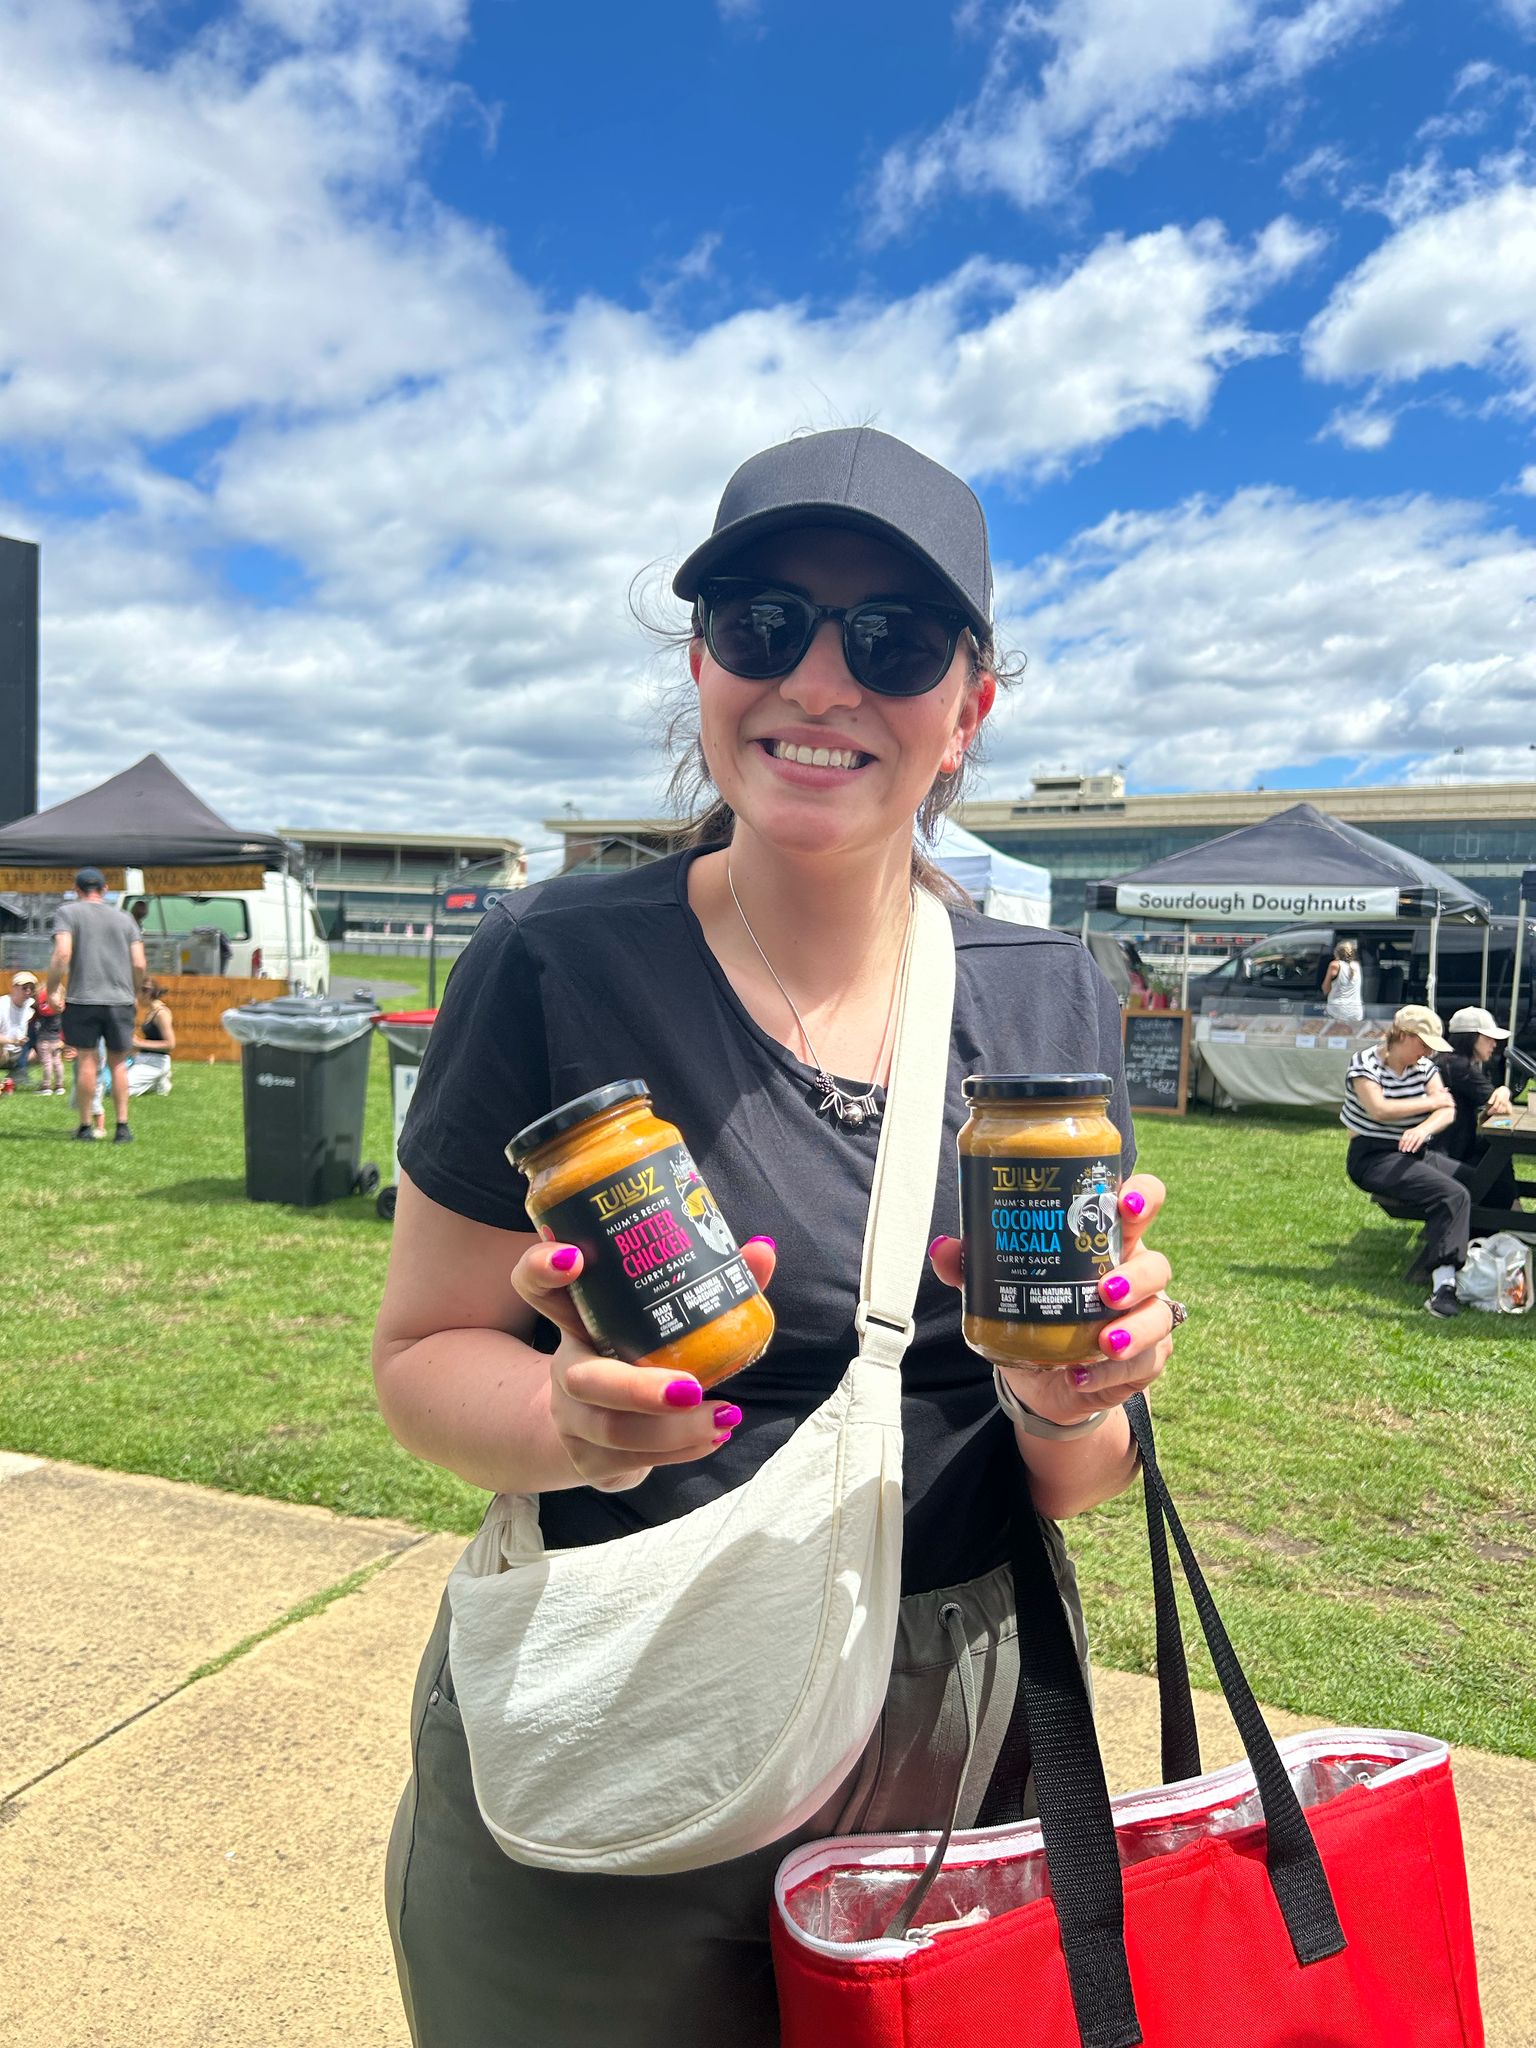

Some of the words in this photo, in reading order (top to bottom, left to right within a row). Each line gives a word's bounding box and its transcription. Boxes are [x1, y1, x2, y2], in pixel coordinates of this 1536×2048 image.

[1138, 893, 1245, 914] Sourdough
[1252, 894, 1367, 915] Doughnuts
[994, 1198, 1025, 1208] MUM'S
[1028, 1199, 1061, 1208] RECIPE
[606, 1213, 639, 1236] MUM'S
[640, 1196, 671, 1217] RECIPE
[991, 1208, 1065, 1231] COCONUT
[614, 1209, 679, 1256] BUTTER
[995, 1230, 1062, 1253] MASALA
[622, 1226, 693, 1278] CHICKEN
[996, 1254, 1025, 1264] CURRY
[1028, 1255, 1061, 1265] SAUCE
[634, 1267, 664, 1289] CURRY
[666, 1250, 697, 1273] SAUCE
[1011, 1268, 1027, 1276] MILD
[653, 1280, 670, 1293] MILD
[682, 1289, 695, 1303] ALL
[693, 1275, 721, 1297] NATURAL
[1000, 1286, 1018, 1295] MADE
[1030, 1287, 1041, 1296] ALL
[1042, 1287, 1072, 1296] NATURAL
[685, 1284, 724, 1310] INGREDIENTS
[1001, 1294, 1016, 1303] EASY
[1030, 1295, 1073, 1304] INGREDIENTS
[652, 1302, 672, 1319] MADE
[657, 1311, 673, 1326] EASY
